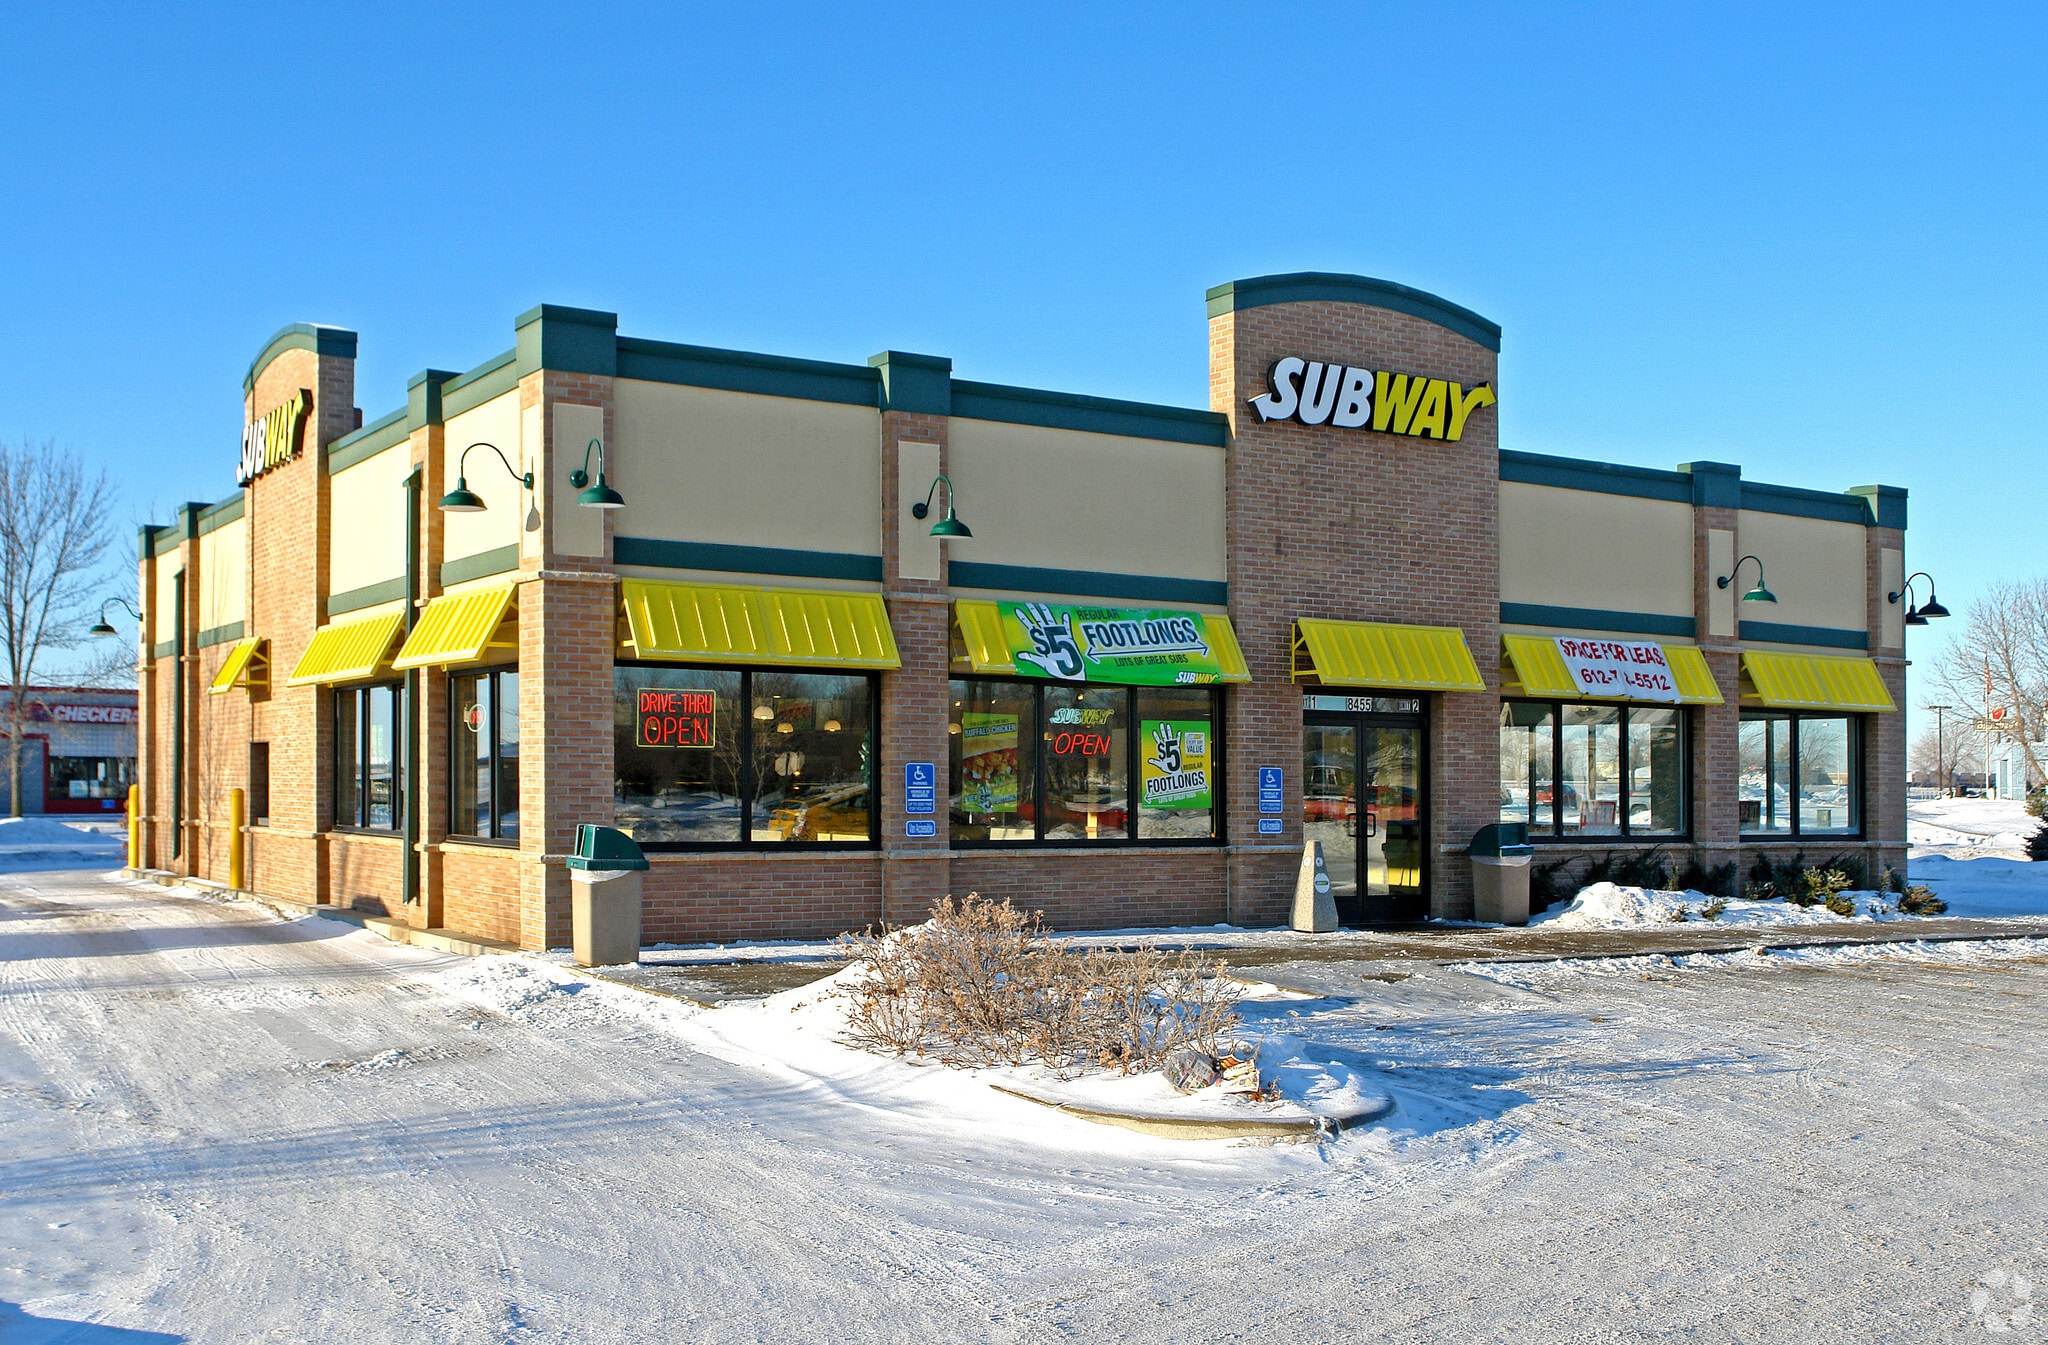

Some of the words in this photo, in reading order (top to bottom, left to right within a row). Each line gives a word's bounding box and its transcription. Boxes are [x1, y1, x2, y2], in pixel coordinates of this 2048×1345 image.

[1249, 356, 1497, 442] SUBWAY
[236, 388, 312, 484] SUBWAY
[1076, 609, 1120, 621] REGULAR
[1082, 619, 1199, 648] FOOTLONGS
[1030, 625, 1083, 677] $5
[1114, 657, 1133, 667] LOTS
[1134, 656, 1144, 666] OF
[1145, 656, 1167, 665] GREAT
[1169, 654, 1189, 664] SUBS
[1559, 639, 1602, 660] SPACE
[1600, 642, 1628, 662] FOR
[1626, 646, 1665, 667] LEAS
[1175, 671, 1220, 684] SUBWAY
[640, 692, 713, 714] DRIVE-THRU
[1311, 696, 1316, 709] 1
[1347, 698, 1371, 711] 8455
[1413, 700, 1419, 713] 2
[1049, 707, 1114, 725] SUBWAY
[643, 715, 709, 745] OPEN
[964, 726, 991, 738] BUFFALO
[991, 723, 1017, 735] CHICKEN
[1054, 732, 1111, 755] OPEN
[1186, 745, 1203, 753] VALUE
[1158, 739, 1181, 772] $5
[1183, 762, 1203, 771] REGULAR
[1147, 771, 1205, 793] FOOTLONGS
